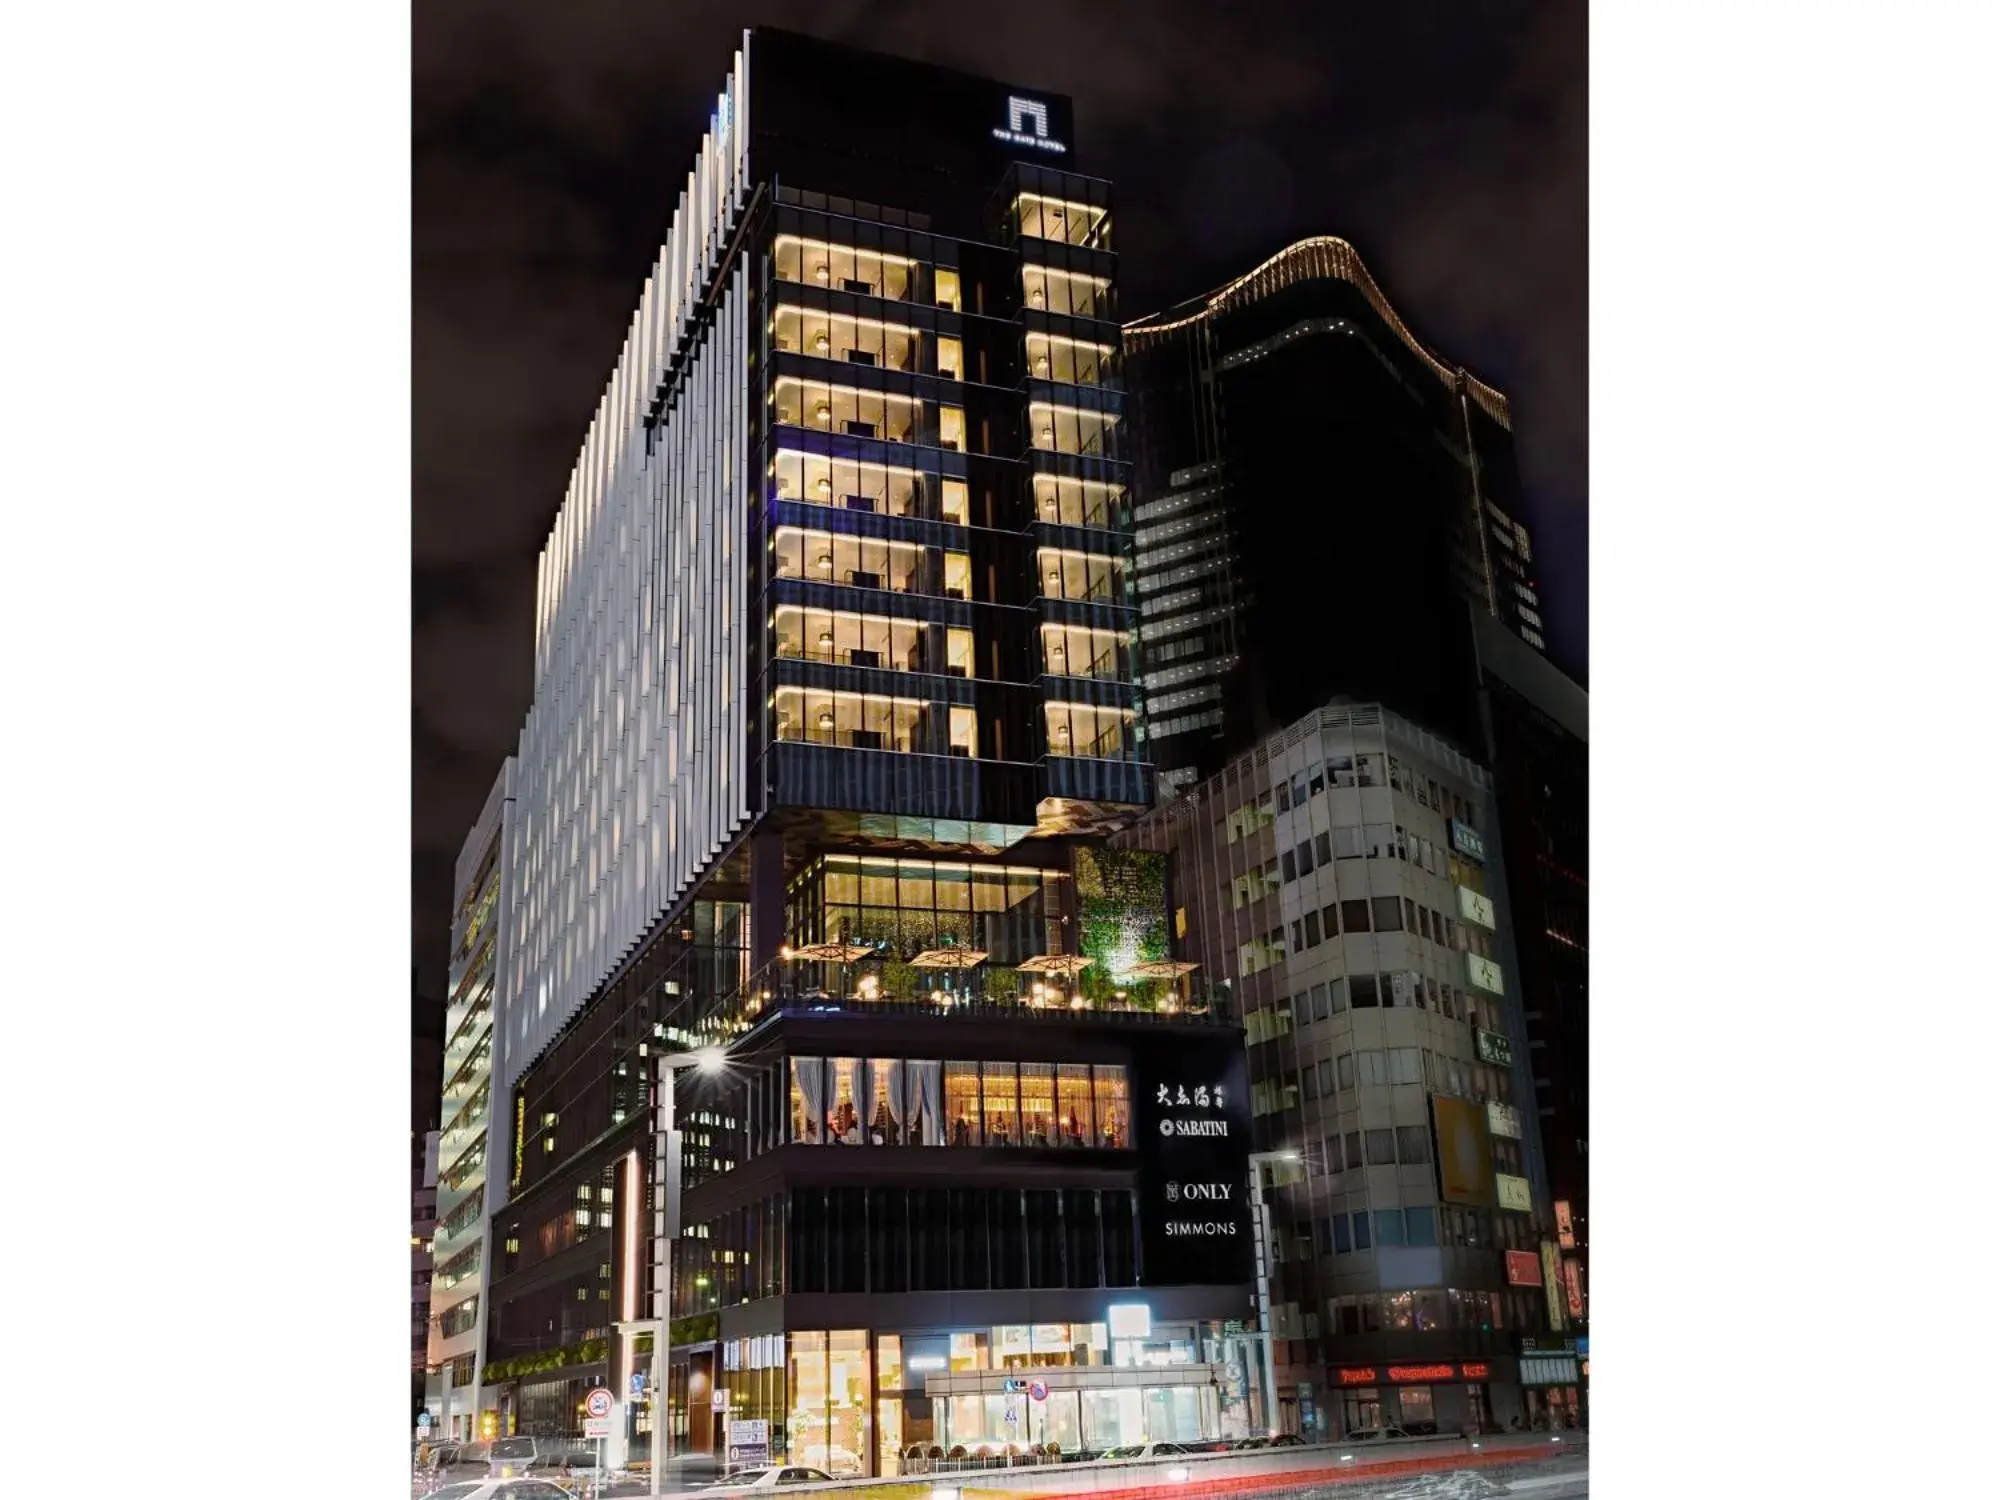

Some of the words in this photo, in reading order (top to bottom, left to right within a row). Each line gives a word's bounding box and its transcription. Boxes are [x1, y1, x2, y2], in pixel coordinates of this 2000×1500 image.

[1176, 1120, 1228, 1136] SABATINI
[1183, 1183, 1232, 1200] ONLY
[1165, 1222, 1237, 1236] SIMMONS
